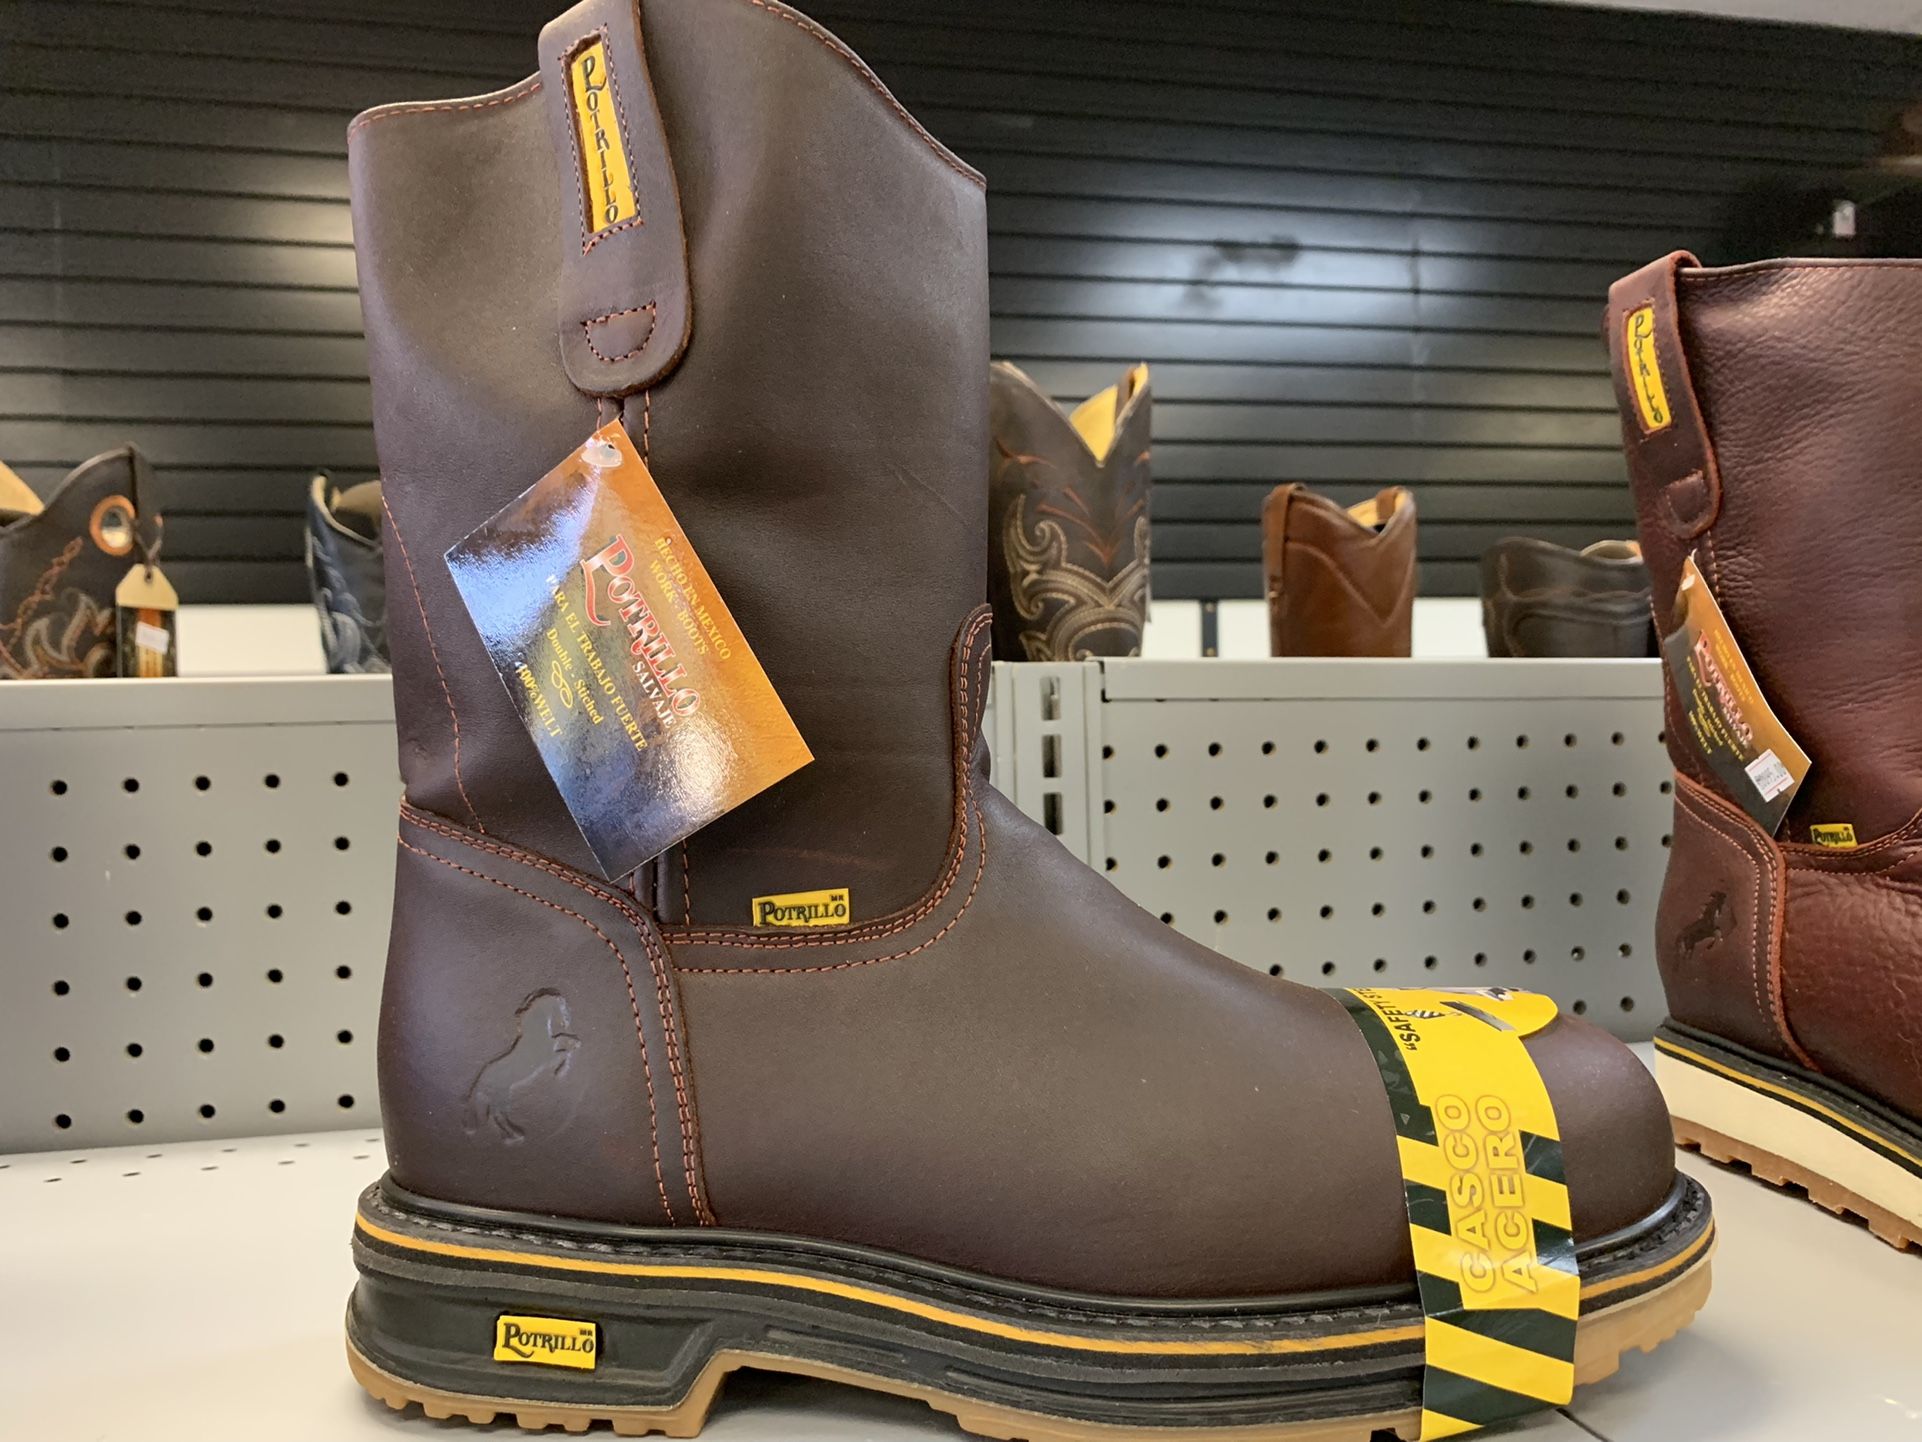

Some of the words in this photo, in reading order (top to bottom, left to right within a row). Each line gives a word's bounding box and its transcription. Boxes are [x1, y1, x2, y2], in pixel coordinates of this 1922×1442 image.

[581, 56, 618, 224] POTRILLO
[580, 533, 701, 717] POTRILLO
[650, 560, 675, 603] WORK
[677, 610, 709, 656] BOOTS
[655, 537, 688, 585] HECHO
[683, 581, 699, 606] EN
[693, 604, 731, 660] MEXICO
[547, 628, 573, 670] Double
[574, 679, 604, 725] Stiched
[565, 612, 581, 633] EL
[577, 631, 616, 695] TRABAJO
[612, 695, 648, 752] FUERTE
[632, 661, 677, 728] SALVAJE
[758, 901, 846, 924] POTRILLO
[1435, 1094, 1496, 1293] CASCO
[1475, 1094, 1539, 1293] ACERO
[502, 1322, 594, 1358] POTRILLO
